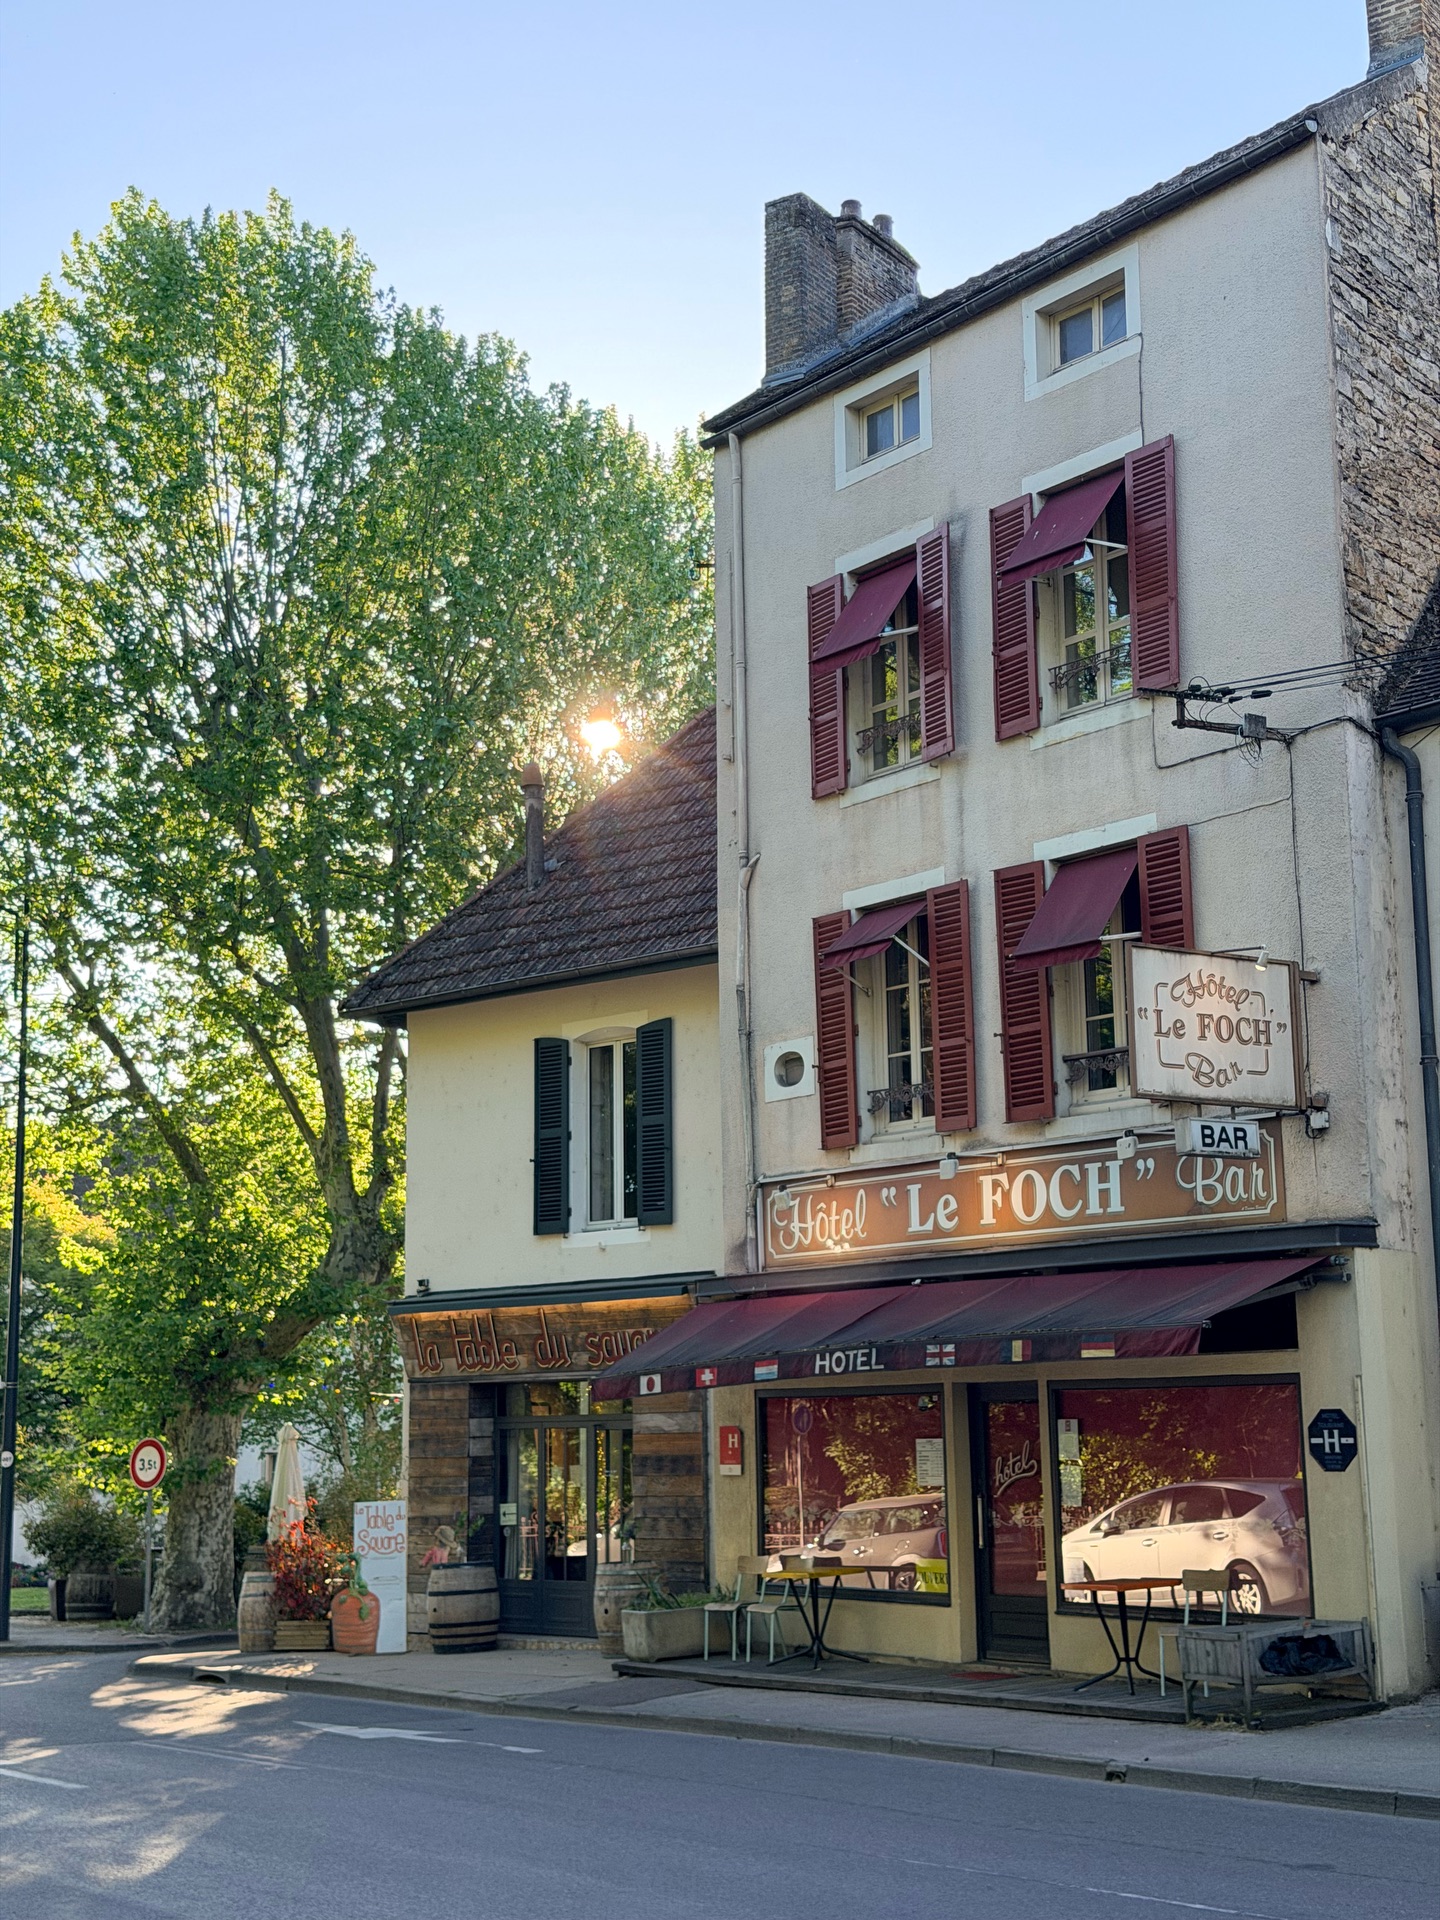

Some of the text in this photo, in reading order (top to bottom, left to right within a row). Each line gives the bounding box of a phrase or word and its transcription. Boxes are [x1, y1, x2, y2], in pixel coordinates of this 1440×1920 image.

[1170, 968, 1250, 1012] Hôtel
[1184, 1051, 1243, 1088] Bar
[1200, 1124, 1248, 1149] BAR
[774, 1188, 868, 1251] Hôtel
[1175, 1156, 1268, 1206] Bar
[410, 1317, 443, 1374] la
[449, 1312, 520, 1373] table
[534, 1307, 572, 1369] du
[814, 1347, 885, 1375] HOTEL
[728, 1432, 739, 1449] H
[1322, 1429, 1342, 1454] H
[364, 1504, 395, 1531] Table
